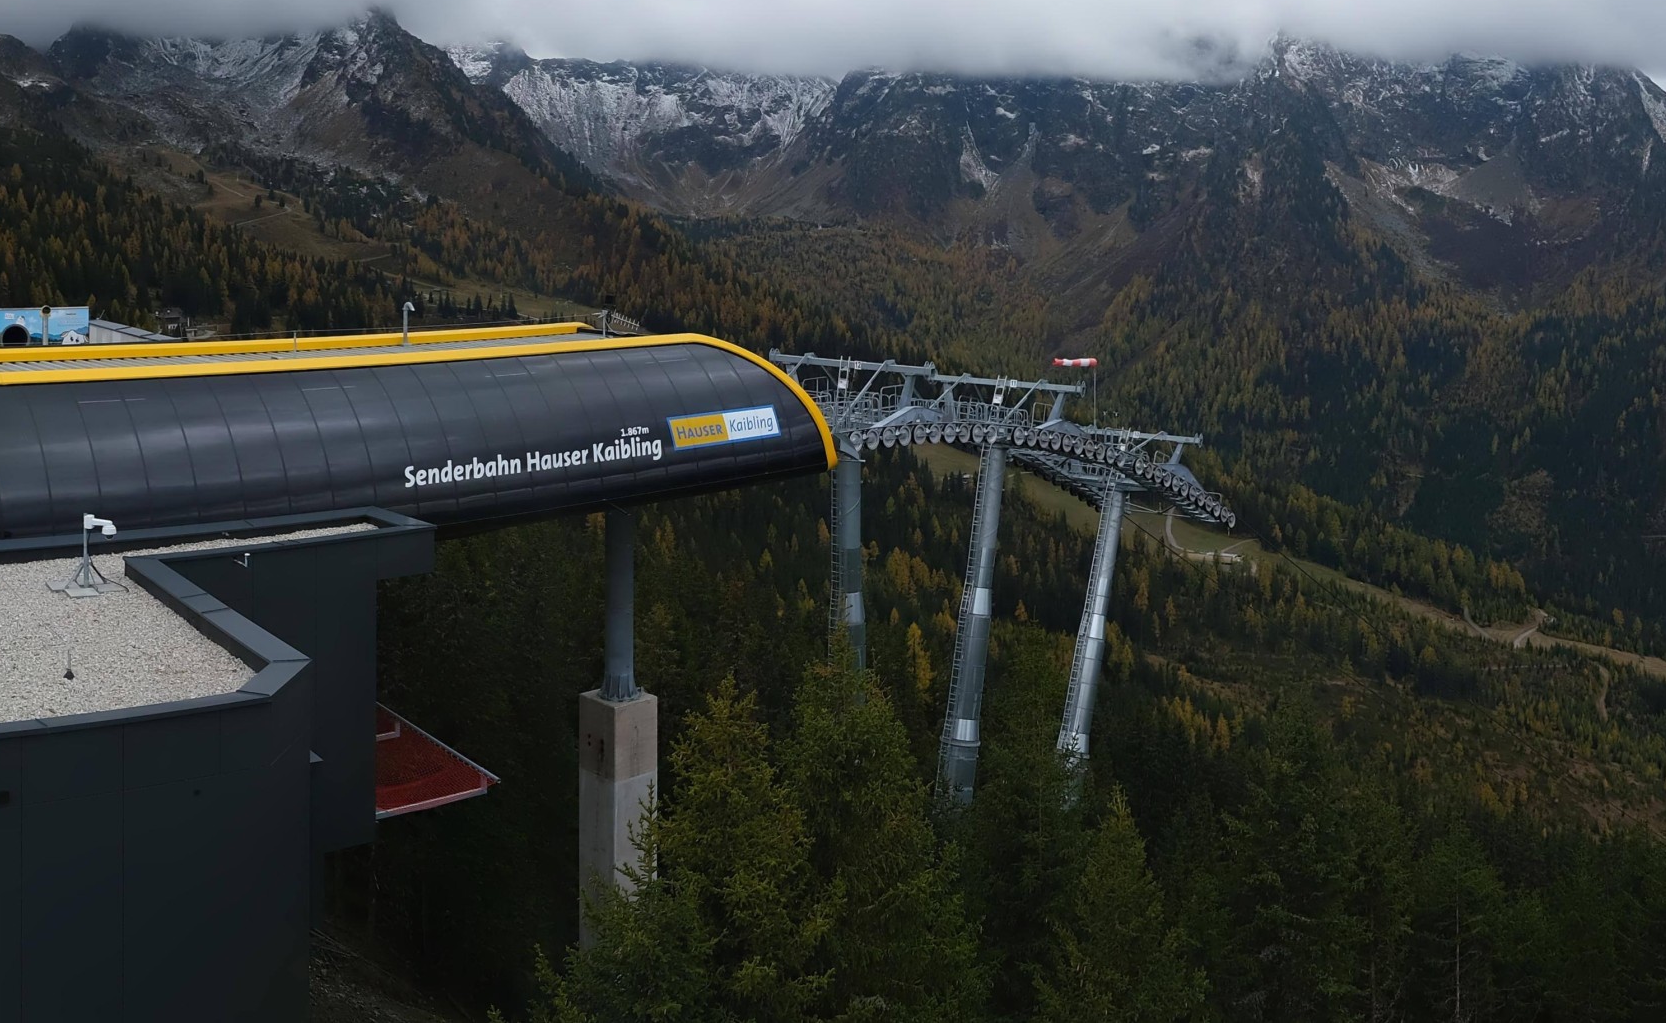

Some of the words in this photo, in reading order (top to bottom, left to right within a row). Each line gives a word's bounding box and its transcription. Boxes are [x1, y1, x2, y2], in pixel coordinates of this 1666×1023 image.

[620, 426, 649, 437] 1.867m
[676, 423, 723, 440] HAUSER
[729, 415, 774, 433] Kaibling
[404, 454, 521, 488] Senderbahn
[526, 448, 589, 472] Hauser
[592, 436, 662, 461] Kaibling
